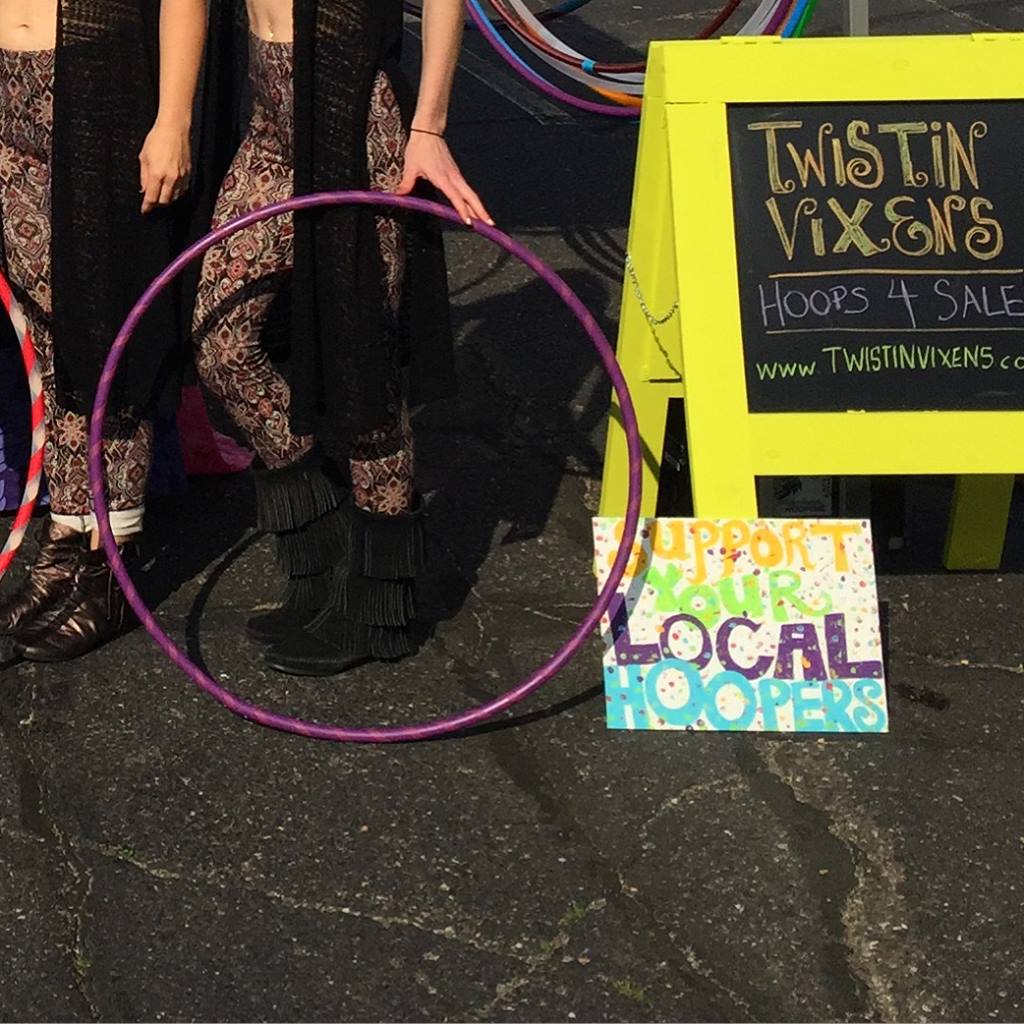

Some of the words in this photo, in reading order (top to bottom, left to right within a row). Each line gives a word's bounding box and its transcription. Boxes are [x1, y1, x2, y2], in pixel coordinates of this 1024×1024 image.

[758, 280, 869, 327] HOOPS
[888, 279, 919, 328] 4
[934, 278, 1024, 321] SALE
[607, 613, 883, 681] LOCAL
[603, 658, 887, 733] HOOPERS
